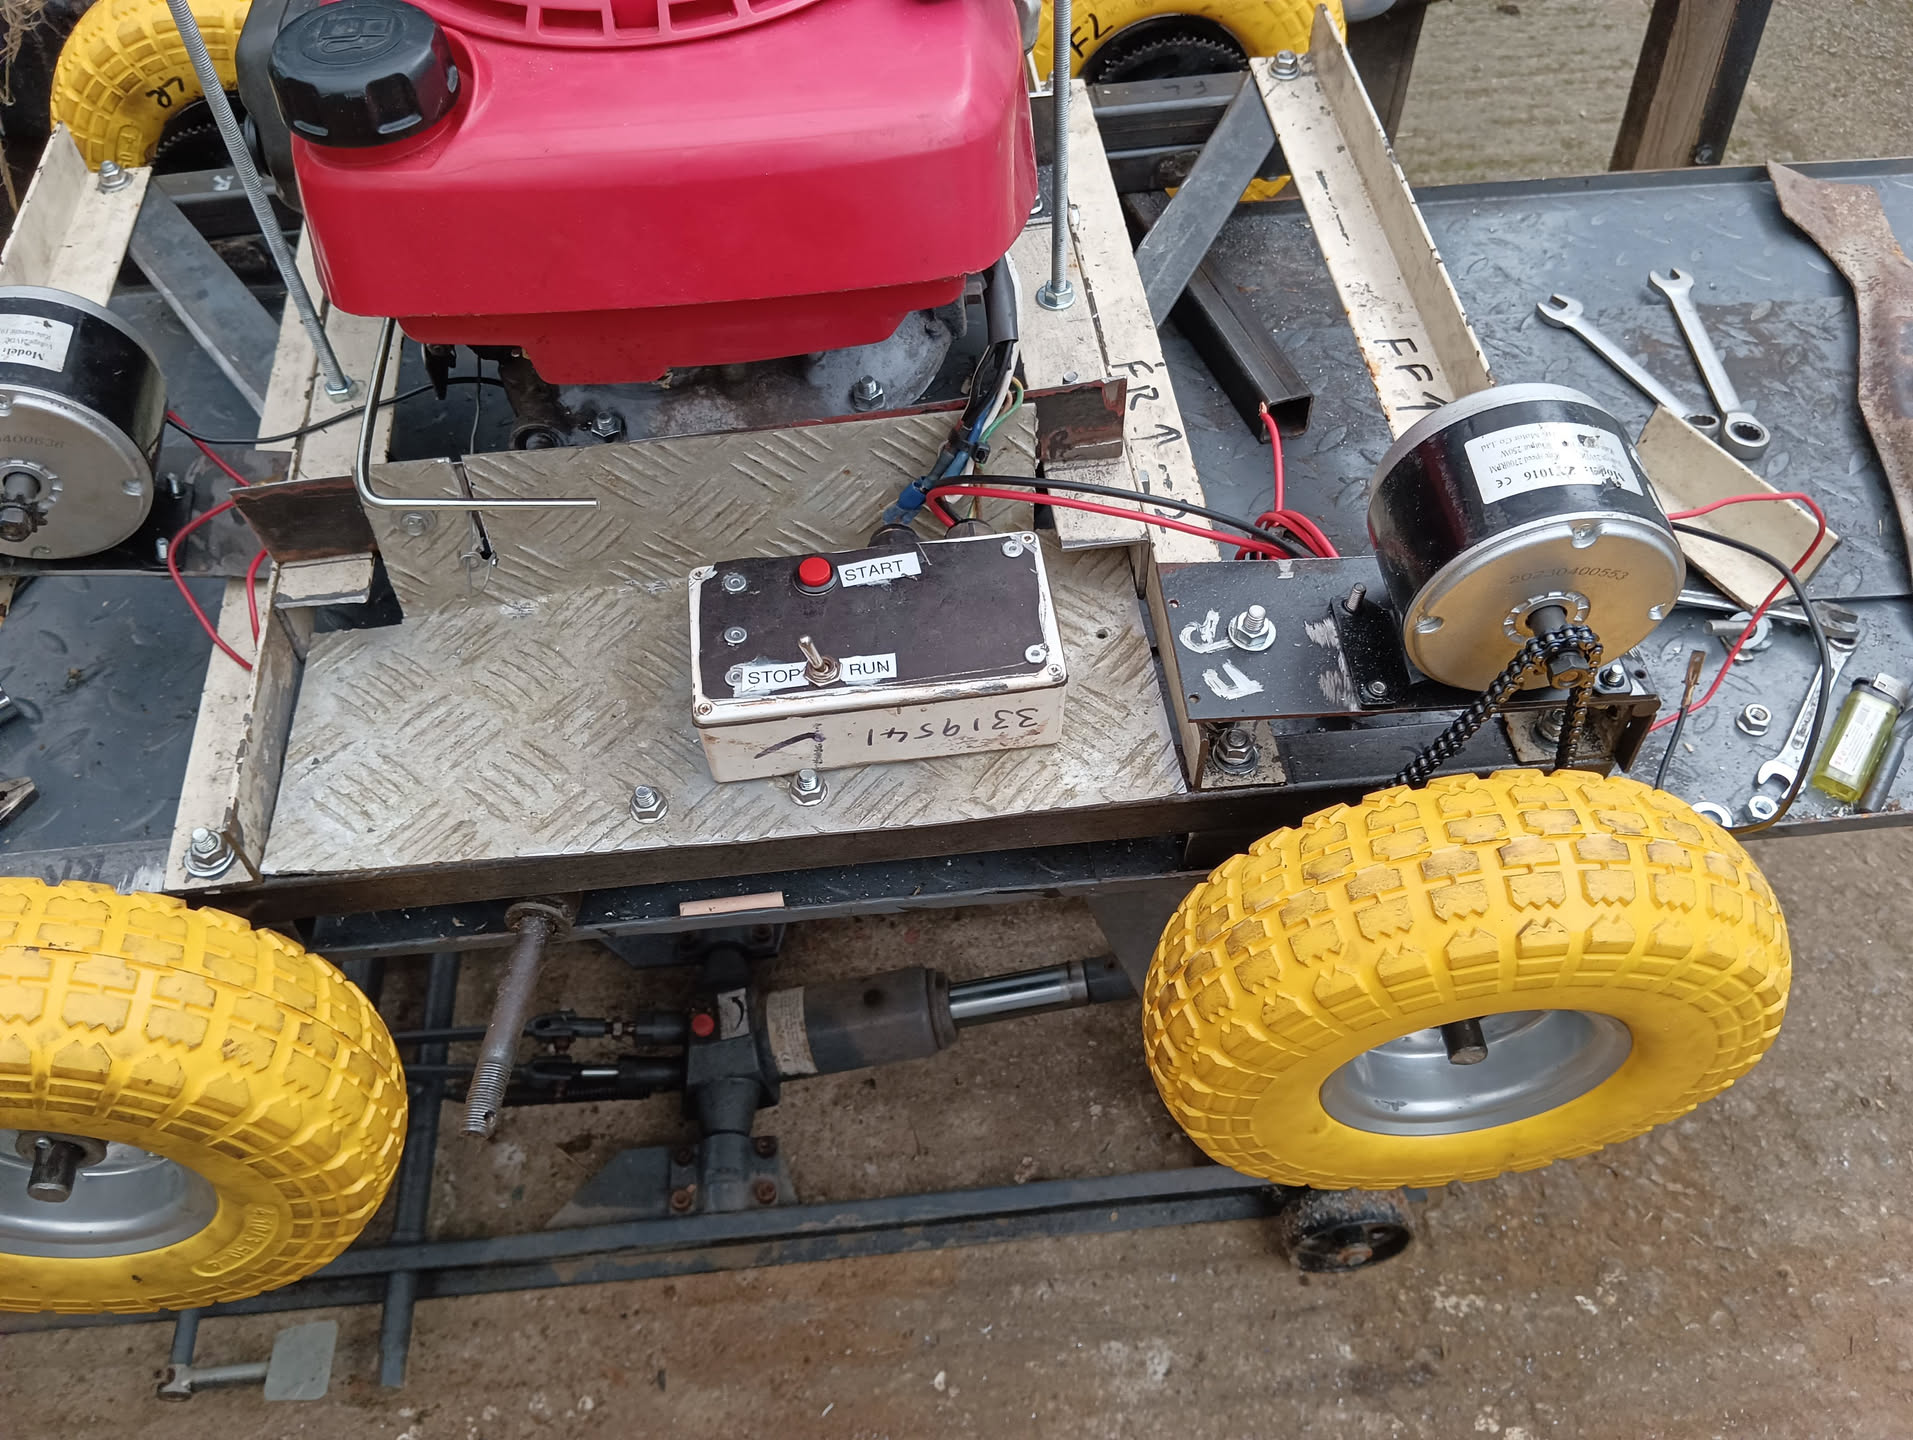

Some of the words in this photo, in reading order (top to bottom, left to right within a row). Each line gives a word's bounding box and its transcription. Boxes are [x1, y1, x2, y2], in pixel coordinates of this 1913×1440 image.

[2, 347, 46, 361] Model:
[844, 560, 904, 581] START
[748, 668, 801, 685] STOP
[849, 659, 890, 676] RUN
[867, 708, 1039, 746] 3319541
